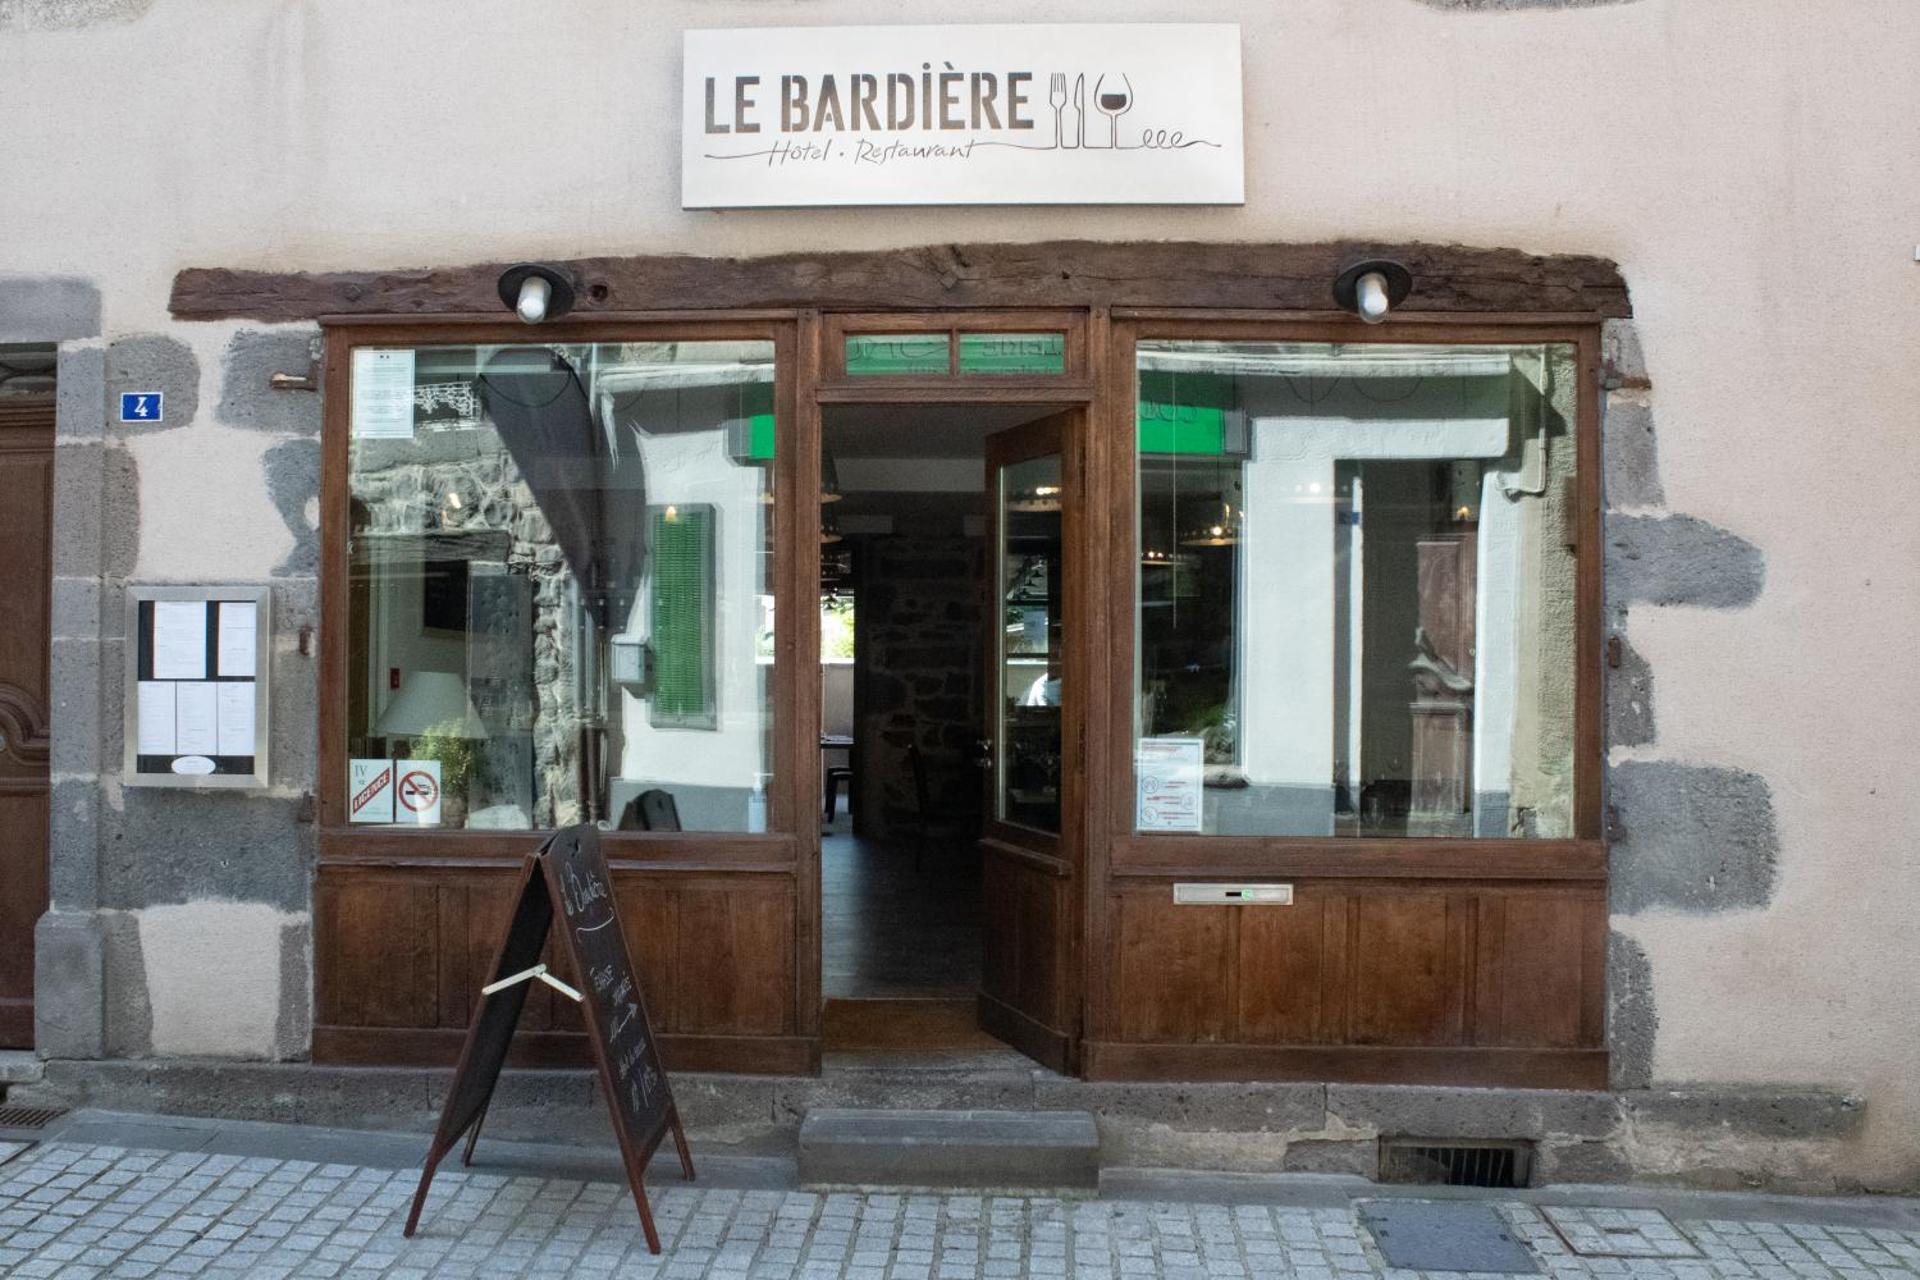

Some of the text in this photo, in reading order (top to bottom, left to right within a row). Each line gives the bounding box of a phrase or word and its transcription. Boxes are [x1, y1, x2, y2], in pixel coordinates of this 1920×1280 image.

[705, 76, 761, 134] LE
[854, 138, 975, 165] Restaurant
[134, 396, 149, 417] 4
